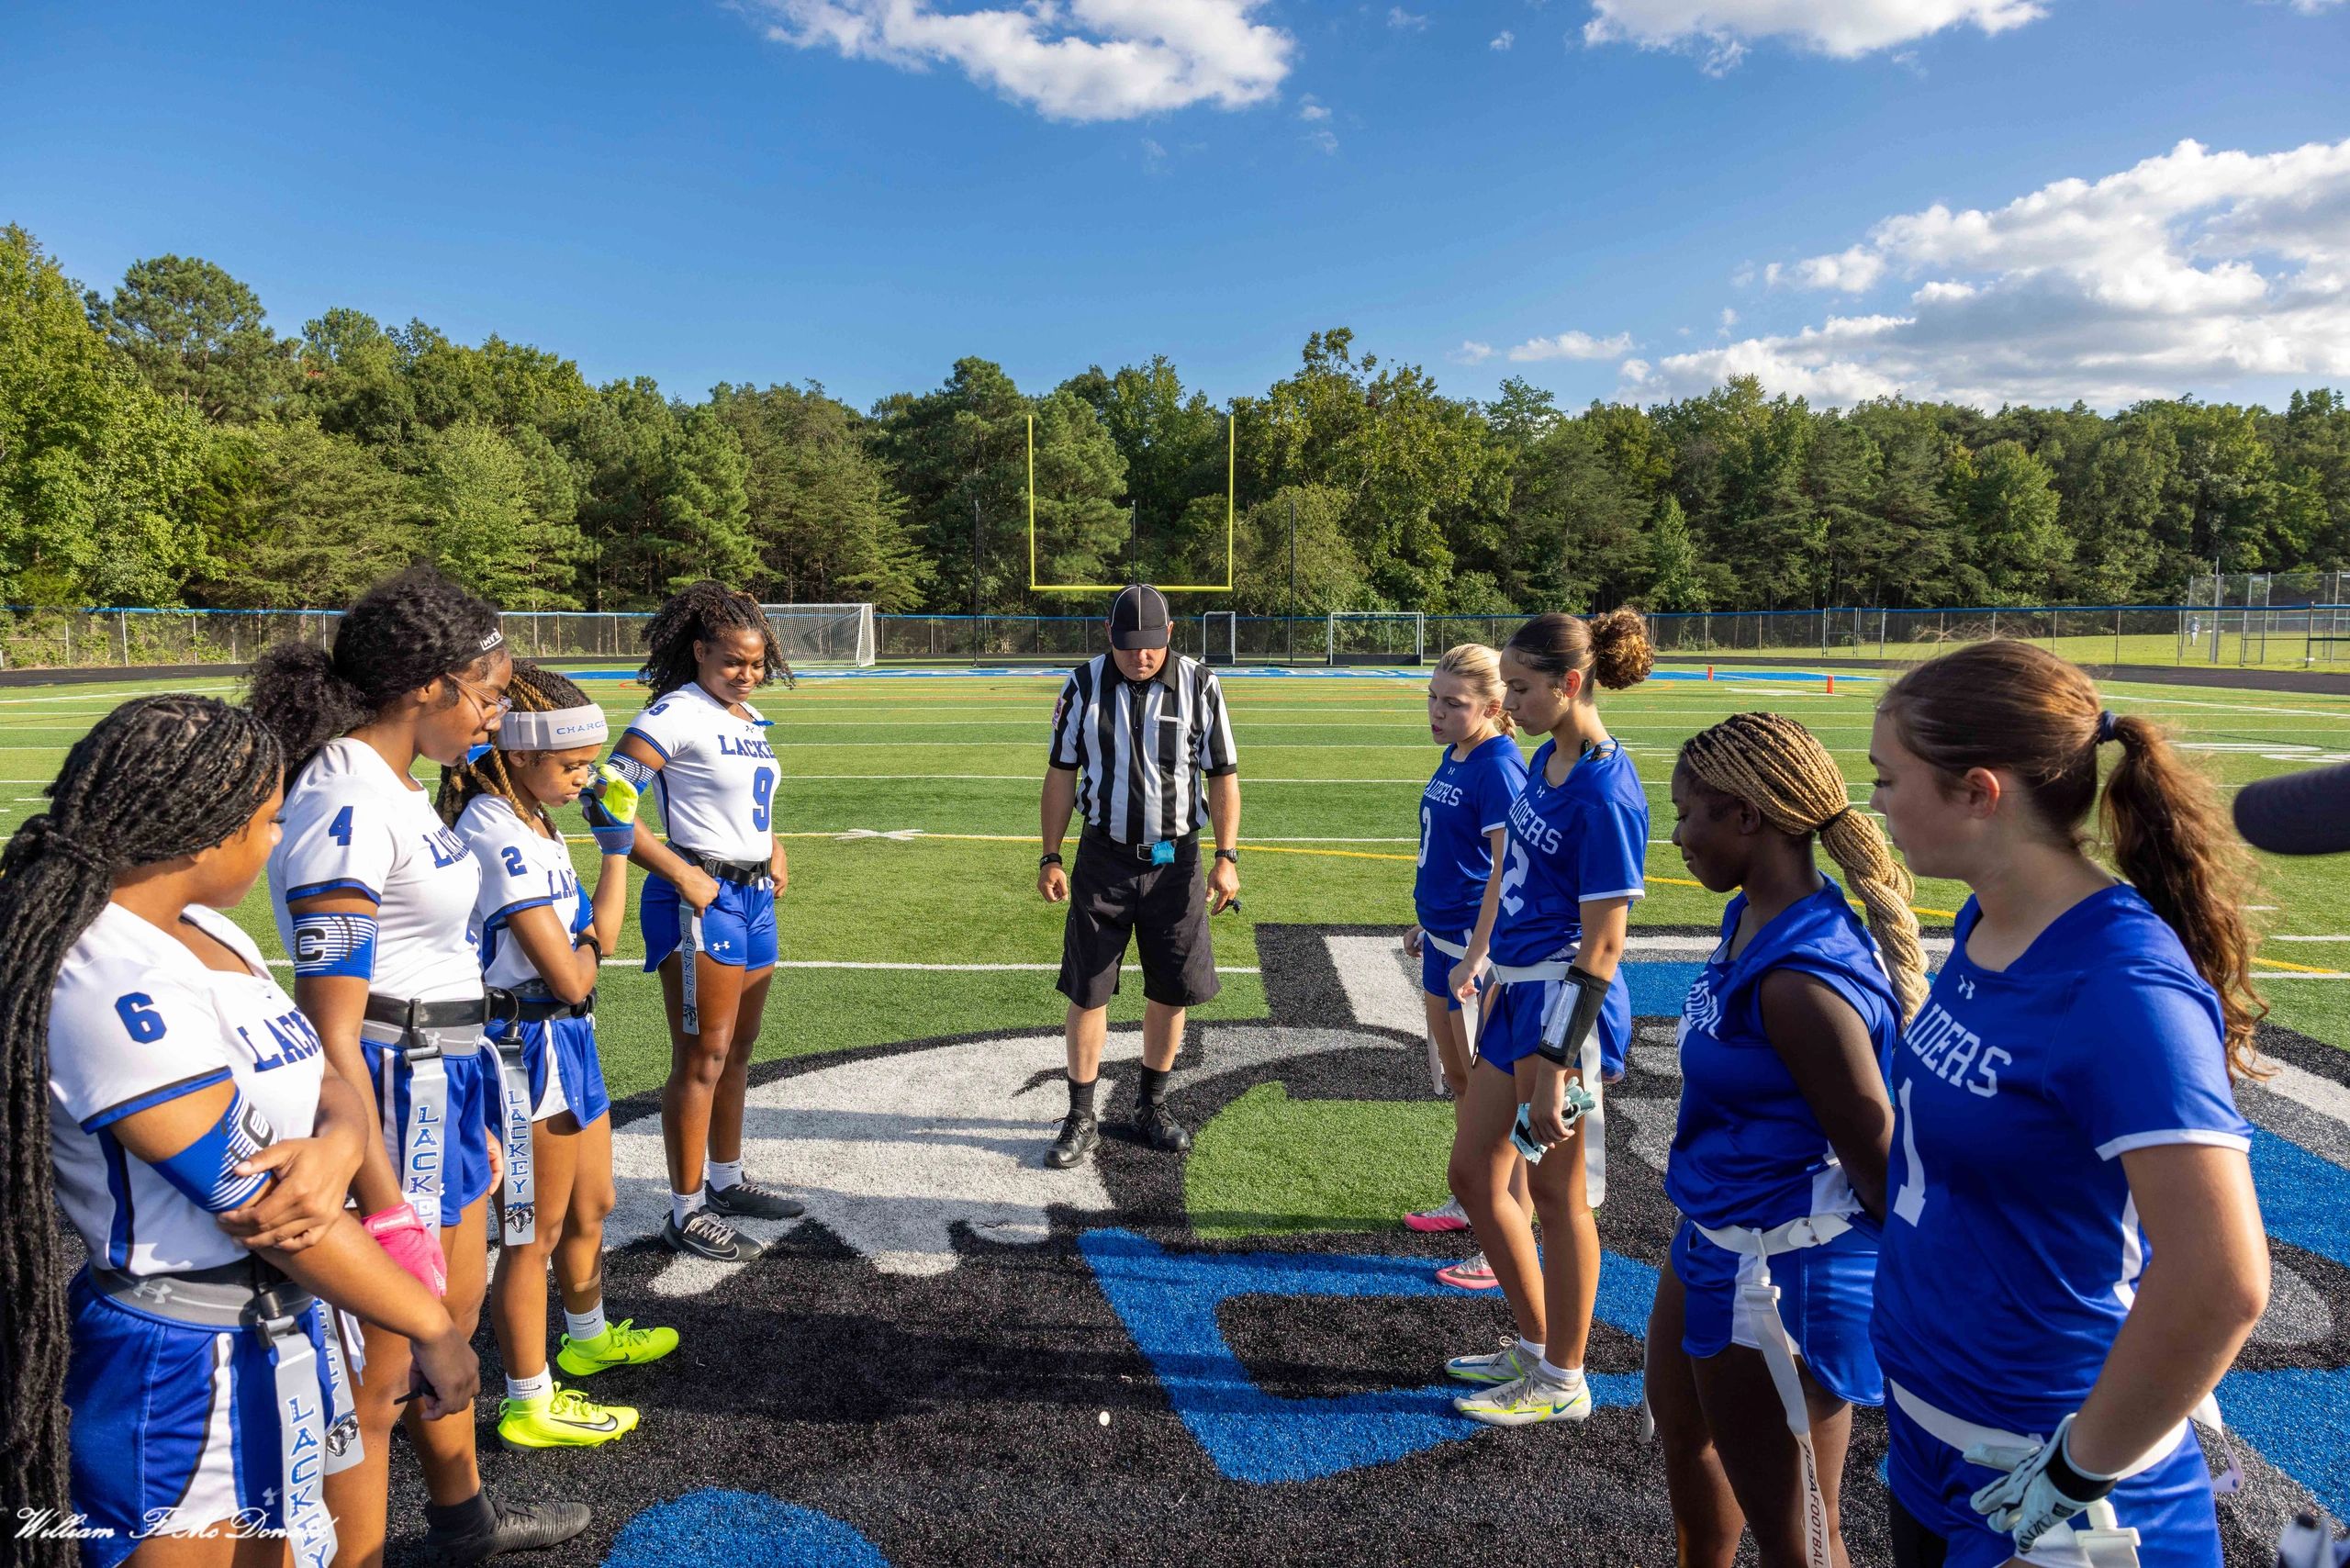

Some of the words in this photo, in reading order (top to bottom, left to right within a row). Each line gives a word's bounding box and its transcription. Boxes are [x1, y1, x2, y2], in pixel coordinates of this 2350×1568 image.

[648, 703, 669, 716] 9
[328, 805, 354, 846] 4
[753, 767, 775, 833] 9
[500, 846, 529, 878] 2
[295, 927, 326, 962] C
[681, 923, 695, 1000] LACKEY
[115, 991, 167, 1045] 6
[408, 1104, 441, 1228] LACKE
[507, 1089, 531, 1195] LACKEY
[1893, 1077, 1927, 1228] 1
[1809, 1492, 1825, 1568] FOOTBAL
